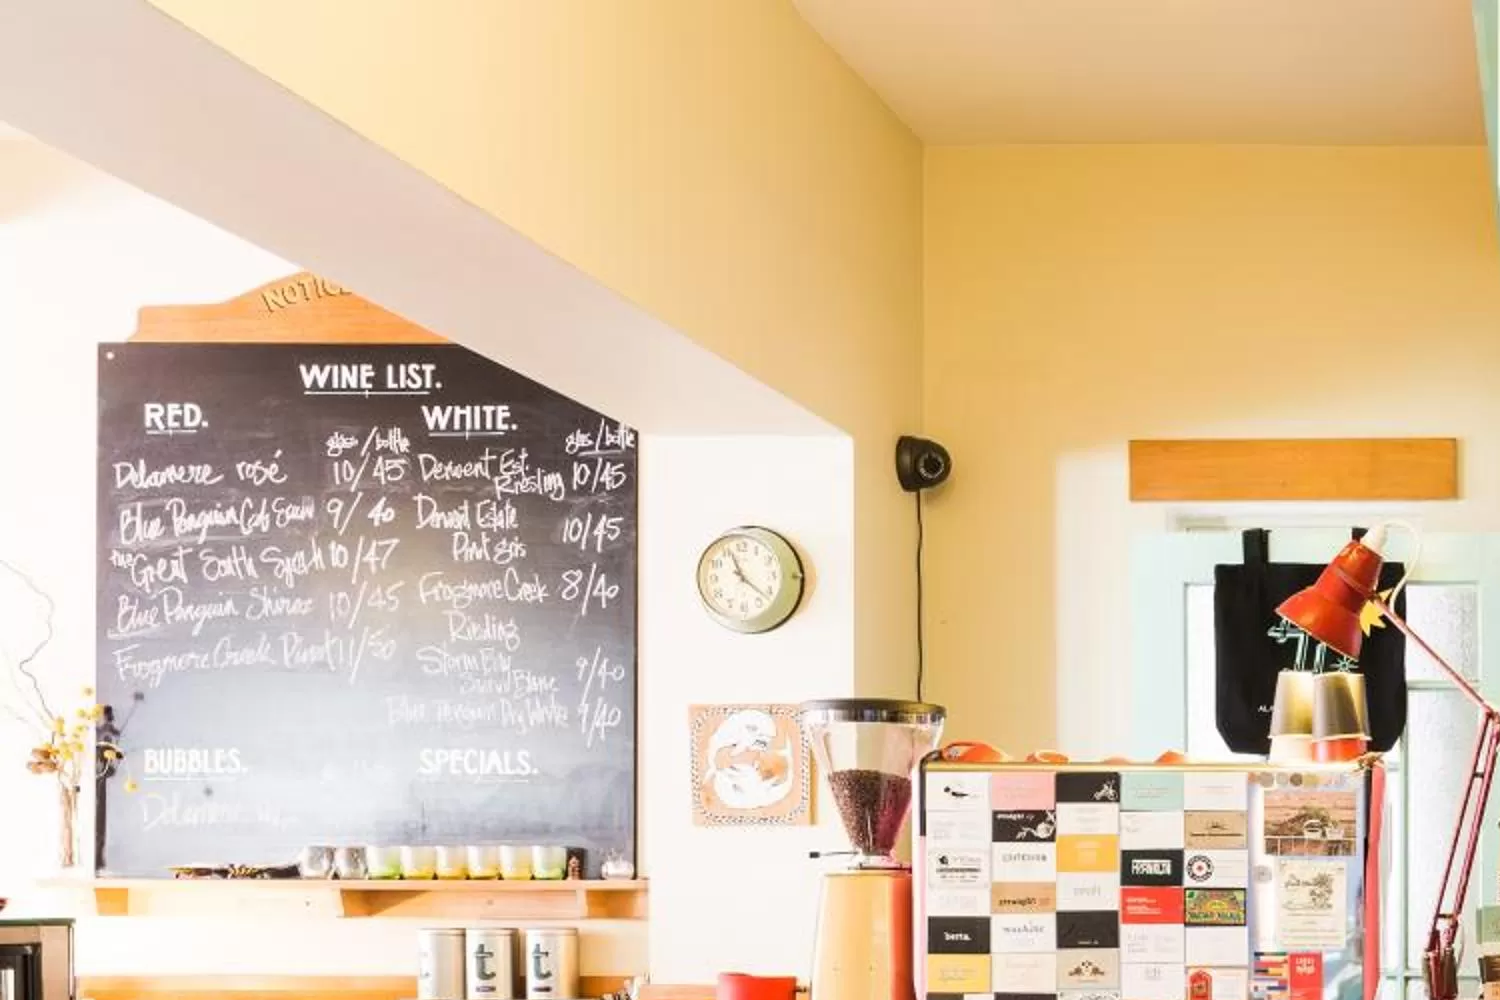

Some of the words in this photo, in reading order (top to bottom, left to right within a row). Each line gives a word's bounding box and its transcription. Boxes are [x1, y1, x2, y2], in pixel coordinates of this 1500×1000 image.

[298, 363, 375, 390] WINE
[387, 363, 443, 390] LIST.
[144, 402, 209, 429] RED.
[420, 404, 519, 431] WHITE.
[236, 449, 288, 487] rosé
[143, 748, 249, 775] BUBBLES.
[416, 748, 540, 775] SPECIALS.
